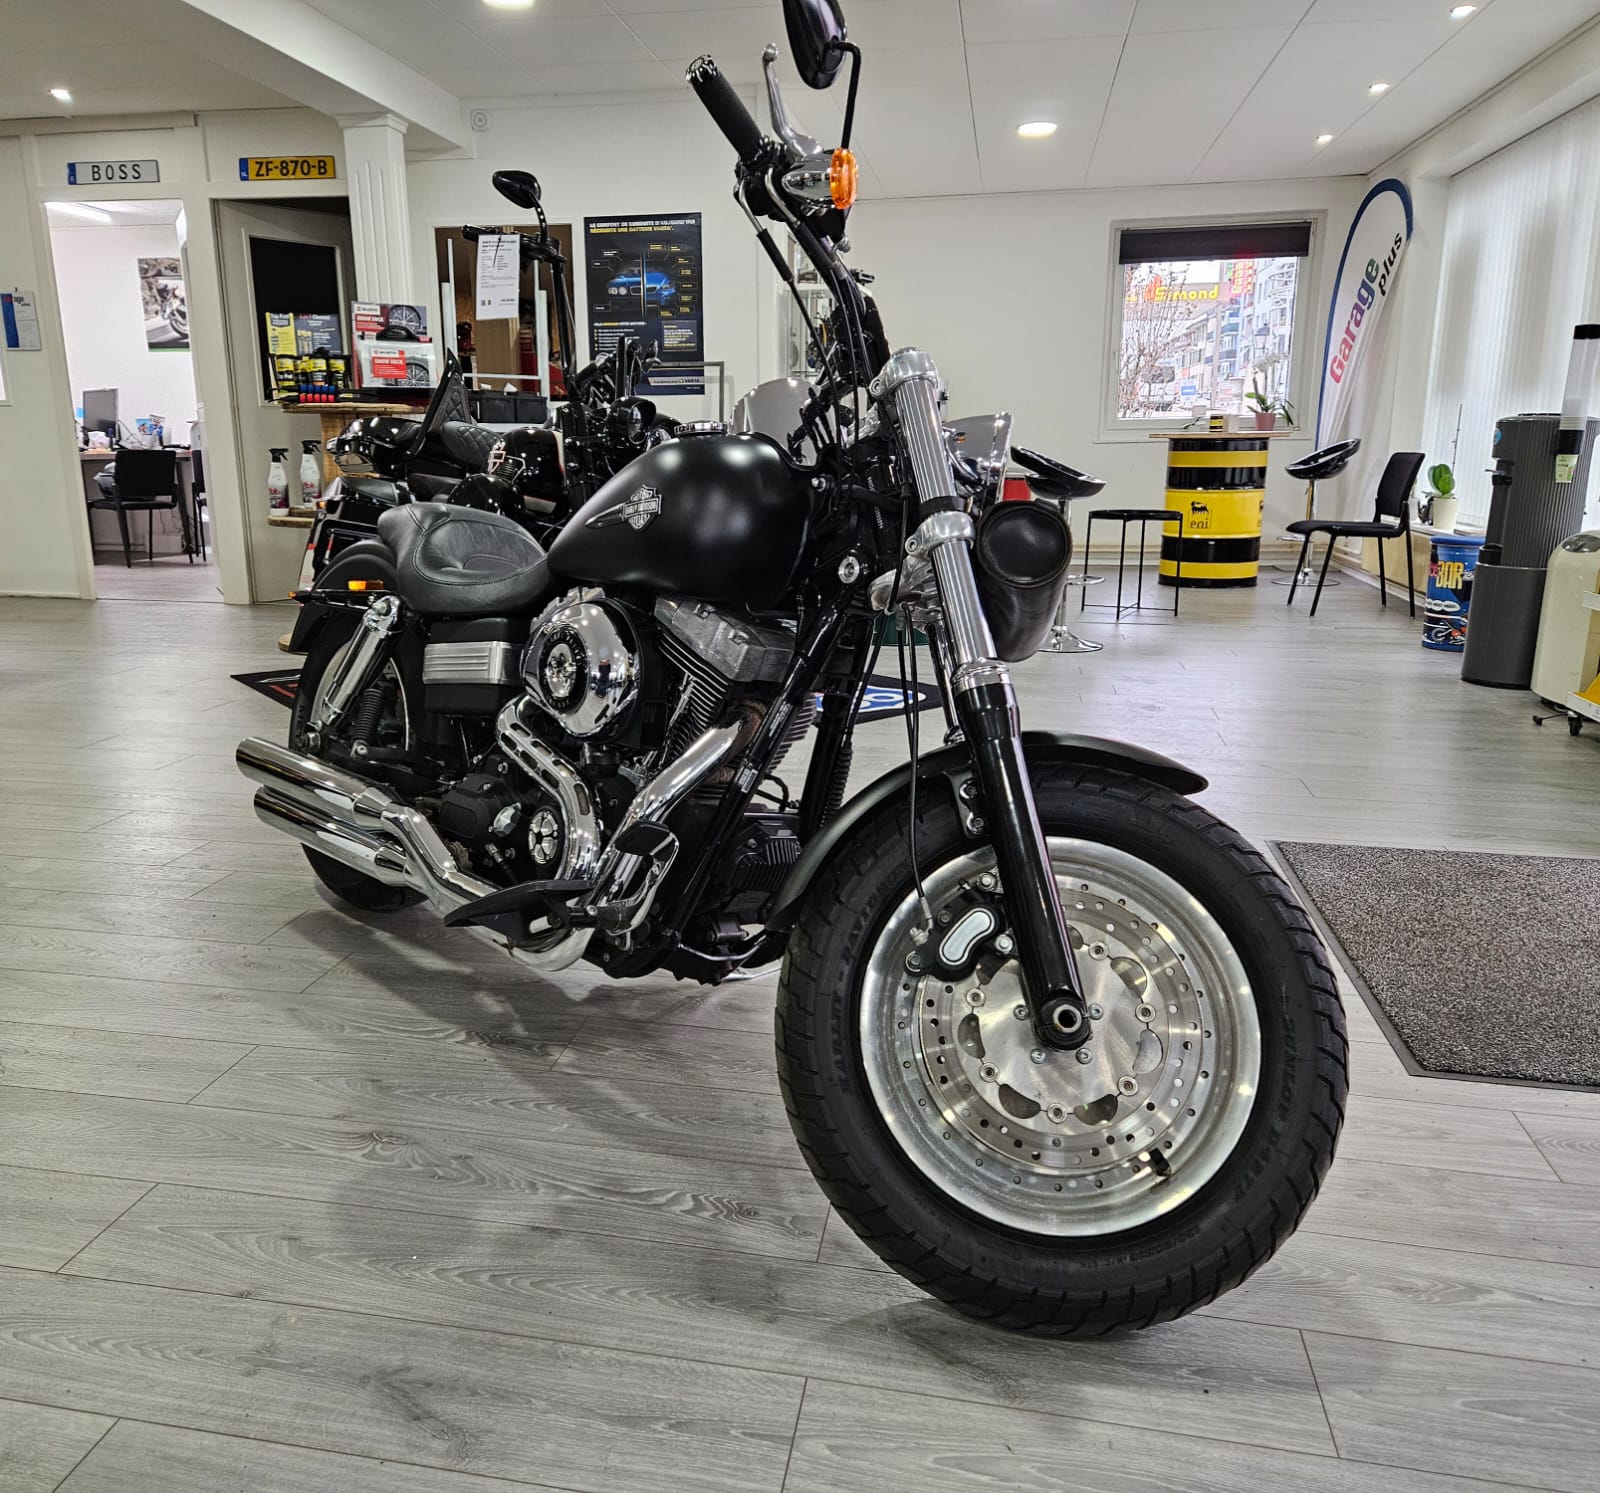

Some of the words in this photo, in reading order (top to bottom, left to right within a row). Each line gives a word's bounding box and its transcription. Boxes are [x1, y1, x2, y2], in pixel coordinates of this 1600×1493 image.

[91, 164, 143, 182] BOSS
[254, 159, 328, 179] ZF-870-B
[1378, 233, 1403, 297] plus
[1330, 258, 1380, 384] Garage
[1189, 518, 1209, 529] eni
[1435, 560, 1465, 590] BAR
